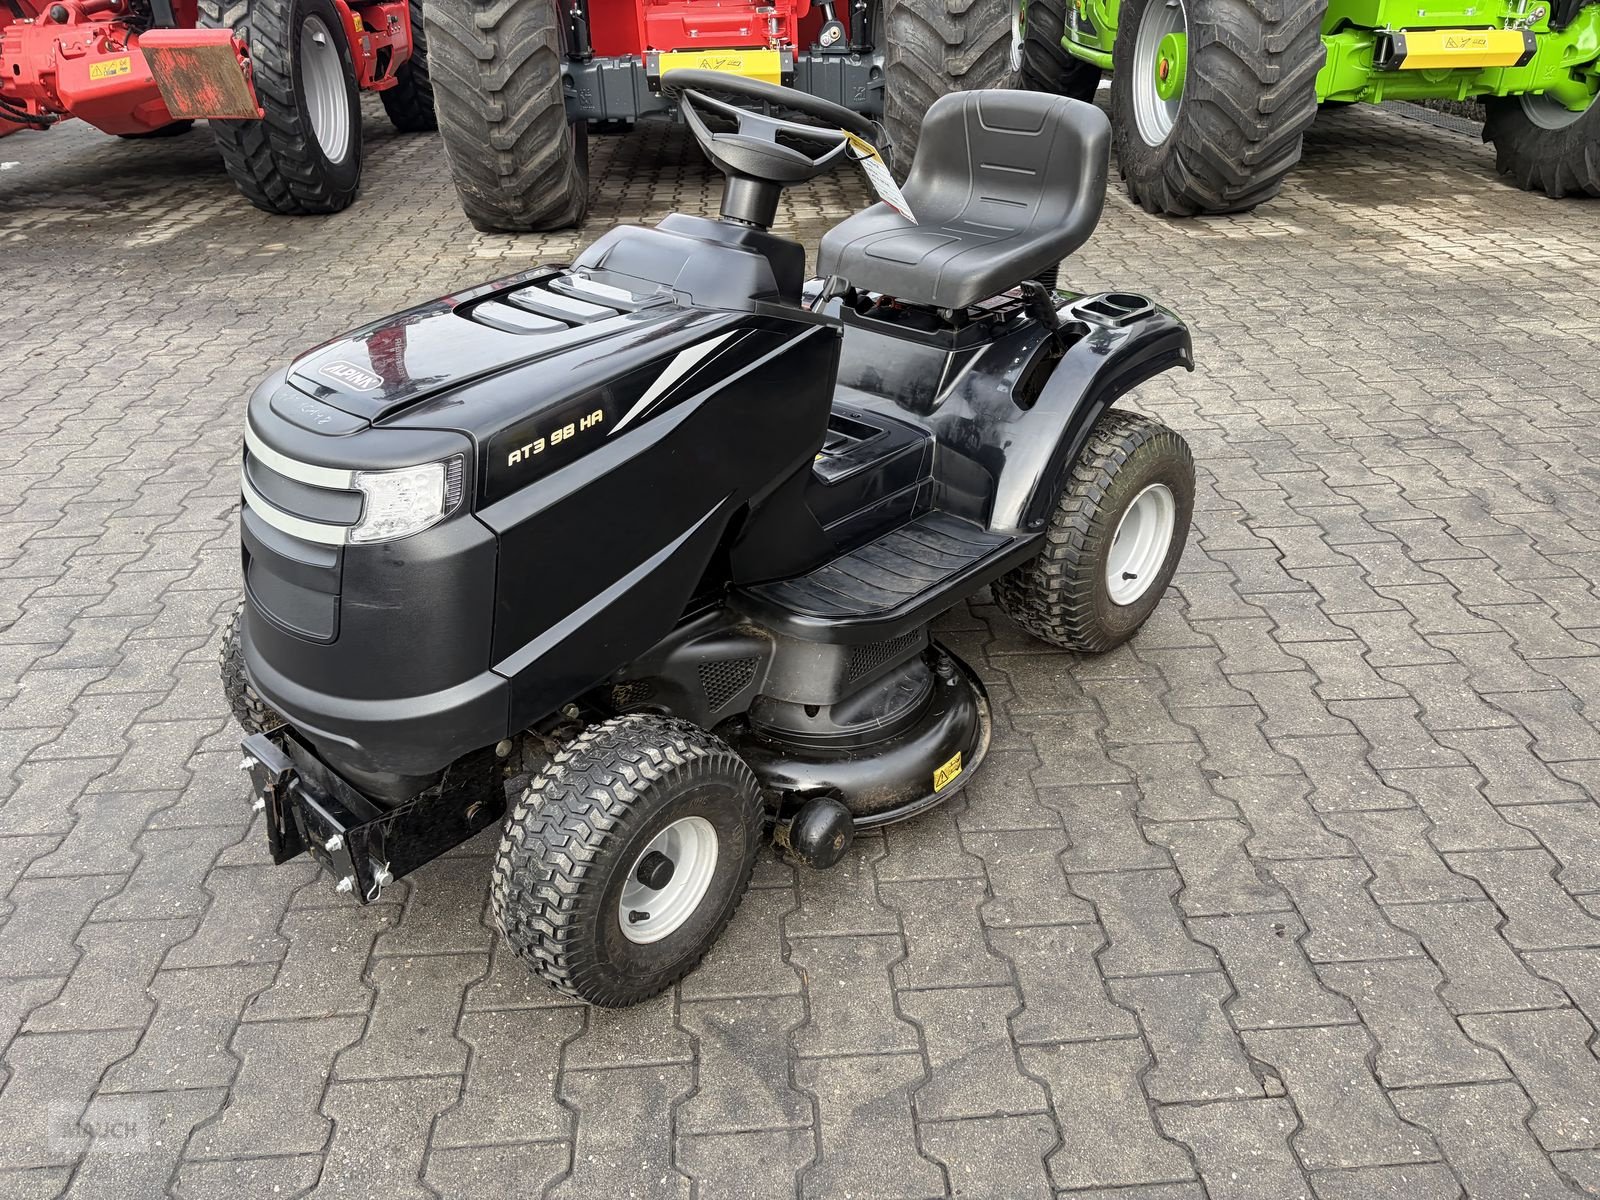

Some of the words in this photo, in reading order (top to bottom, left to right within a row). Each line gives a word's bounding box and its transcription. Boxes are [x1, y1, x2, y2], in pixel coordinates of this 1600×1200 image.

[507, 437, 546, 467] AT3
[550, 423, 575, 447] 98
[580, 409, 604, 432] HA
